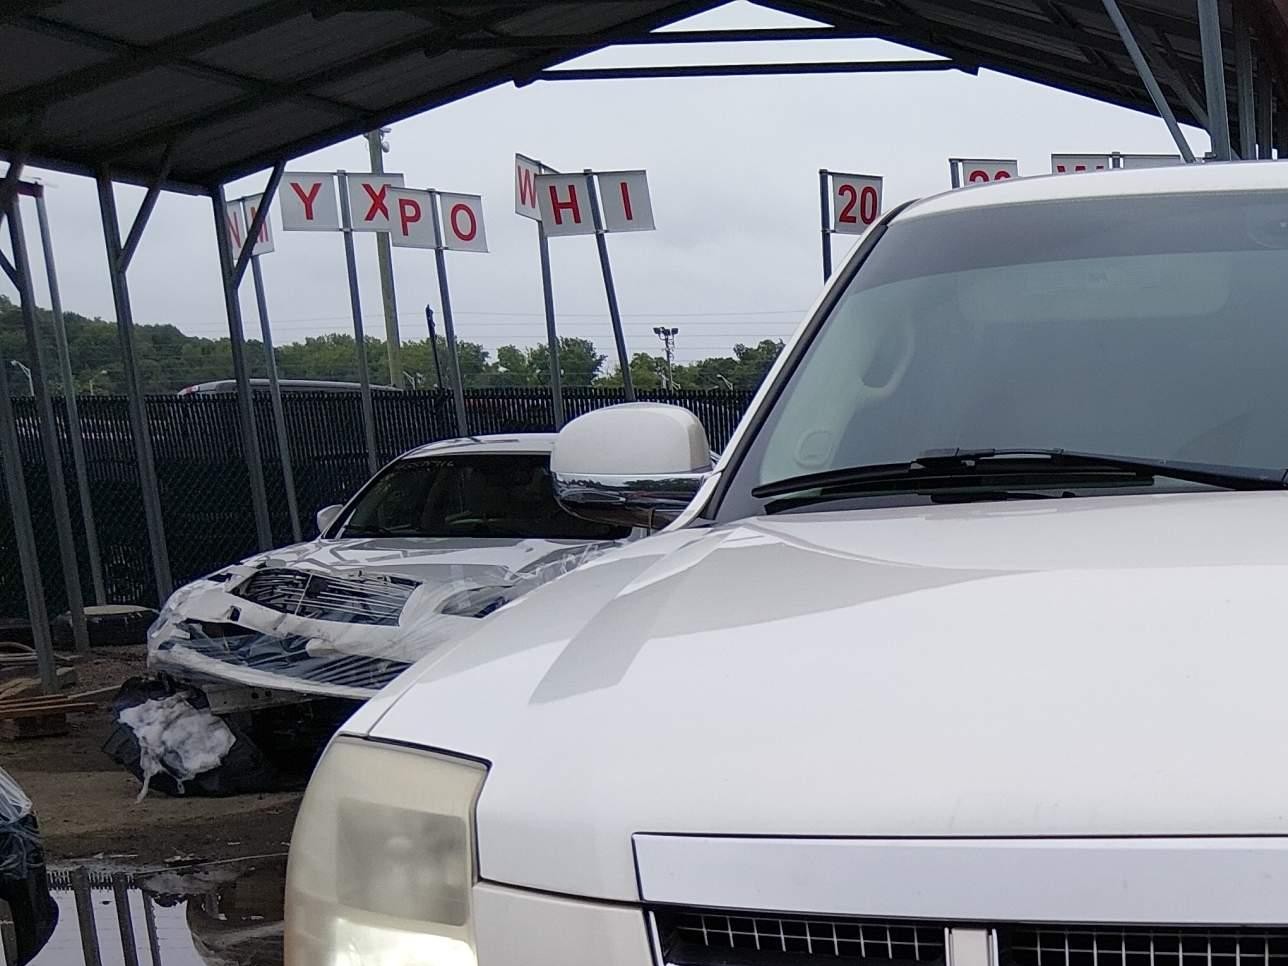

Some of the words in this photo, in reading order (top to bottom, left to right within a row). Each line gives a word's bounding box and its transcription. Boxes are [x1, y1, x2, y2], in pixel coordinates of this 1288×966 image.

[290, 183, 323, 221] Y
[361, 183, 392, 221] X
[518, 165, 537, 208] W
[549, 184, 582, 225] H
[620, 182, 633, 221] I
[838, 183, 878, 225] 20
[398, 198, 422, 237] P
[450, 203, 477, 242] O
